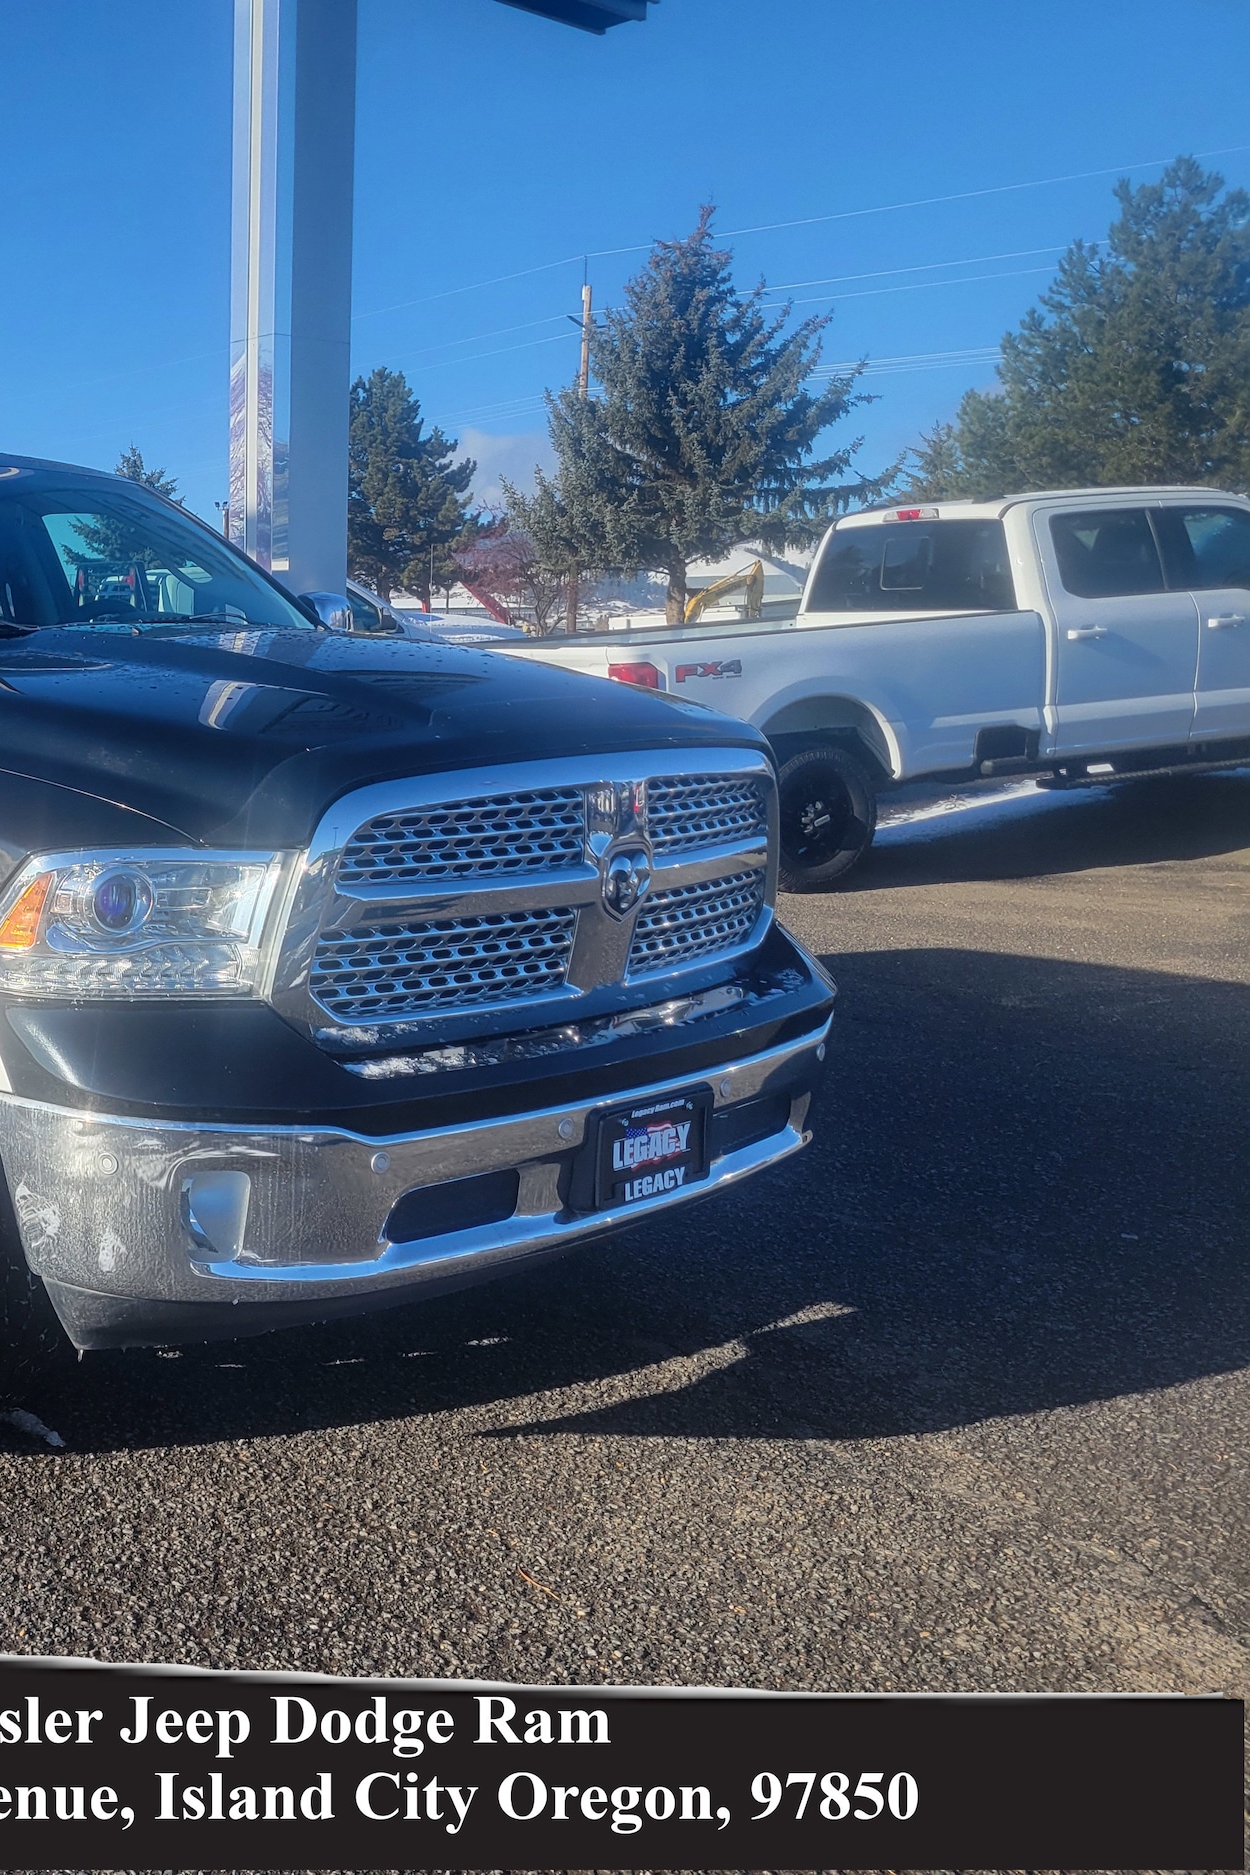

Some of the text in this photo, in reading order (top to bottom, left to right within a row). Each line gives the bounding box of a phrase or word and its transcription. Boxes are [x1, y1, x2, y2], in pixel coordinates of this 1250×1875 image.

[675, 659, 742, 683] FX4
[613, 1123, 690, 1170] LEGACY
[625, 1166, 685, 1201] LEGACY
